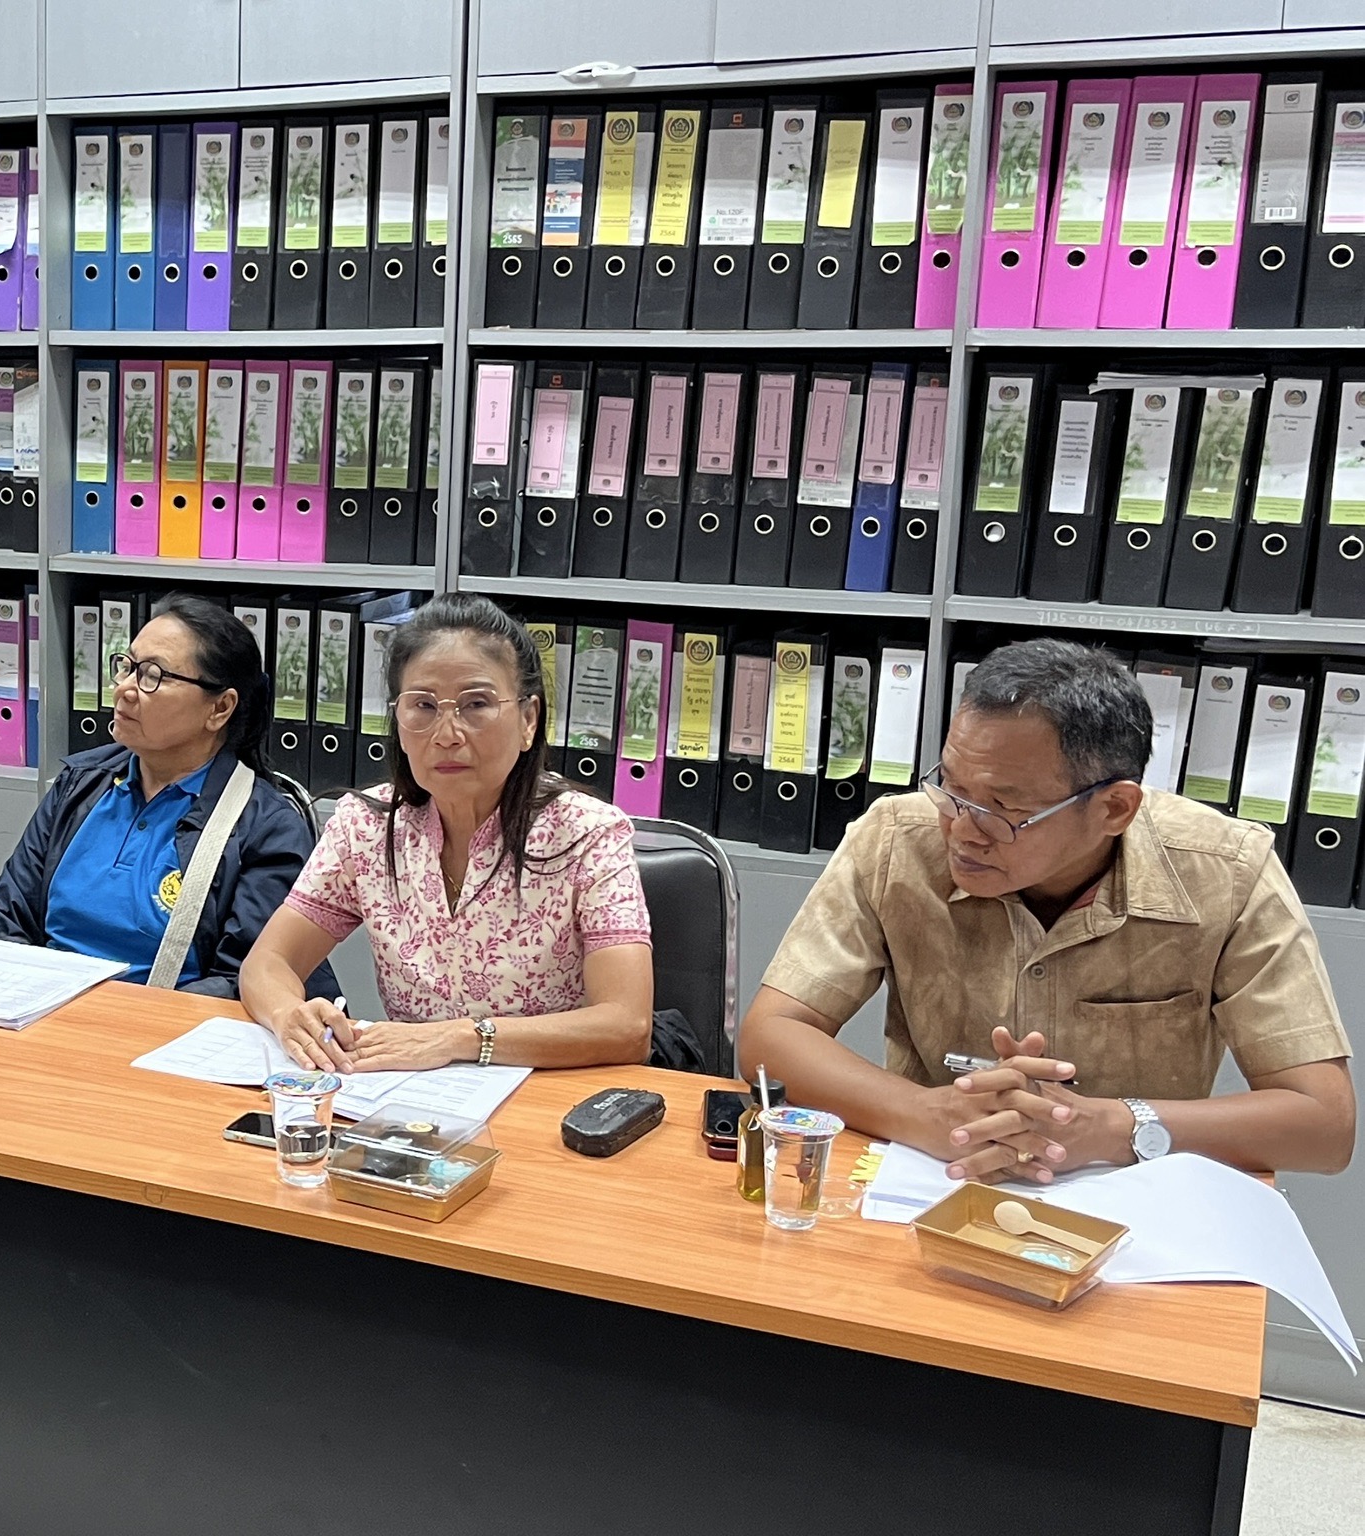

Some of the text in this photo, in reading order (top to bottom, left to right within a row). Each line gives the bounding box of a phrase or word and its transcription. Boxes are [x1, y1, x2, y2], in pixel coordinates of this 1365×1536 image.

[1261, 171, 1269, 192] FILE
[502, 234, 523, 244] 2565
[579, 735, 599, 747] 2565
